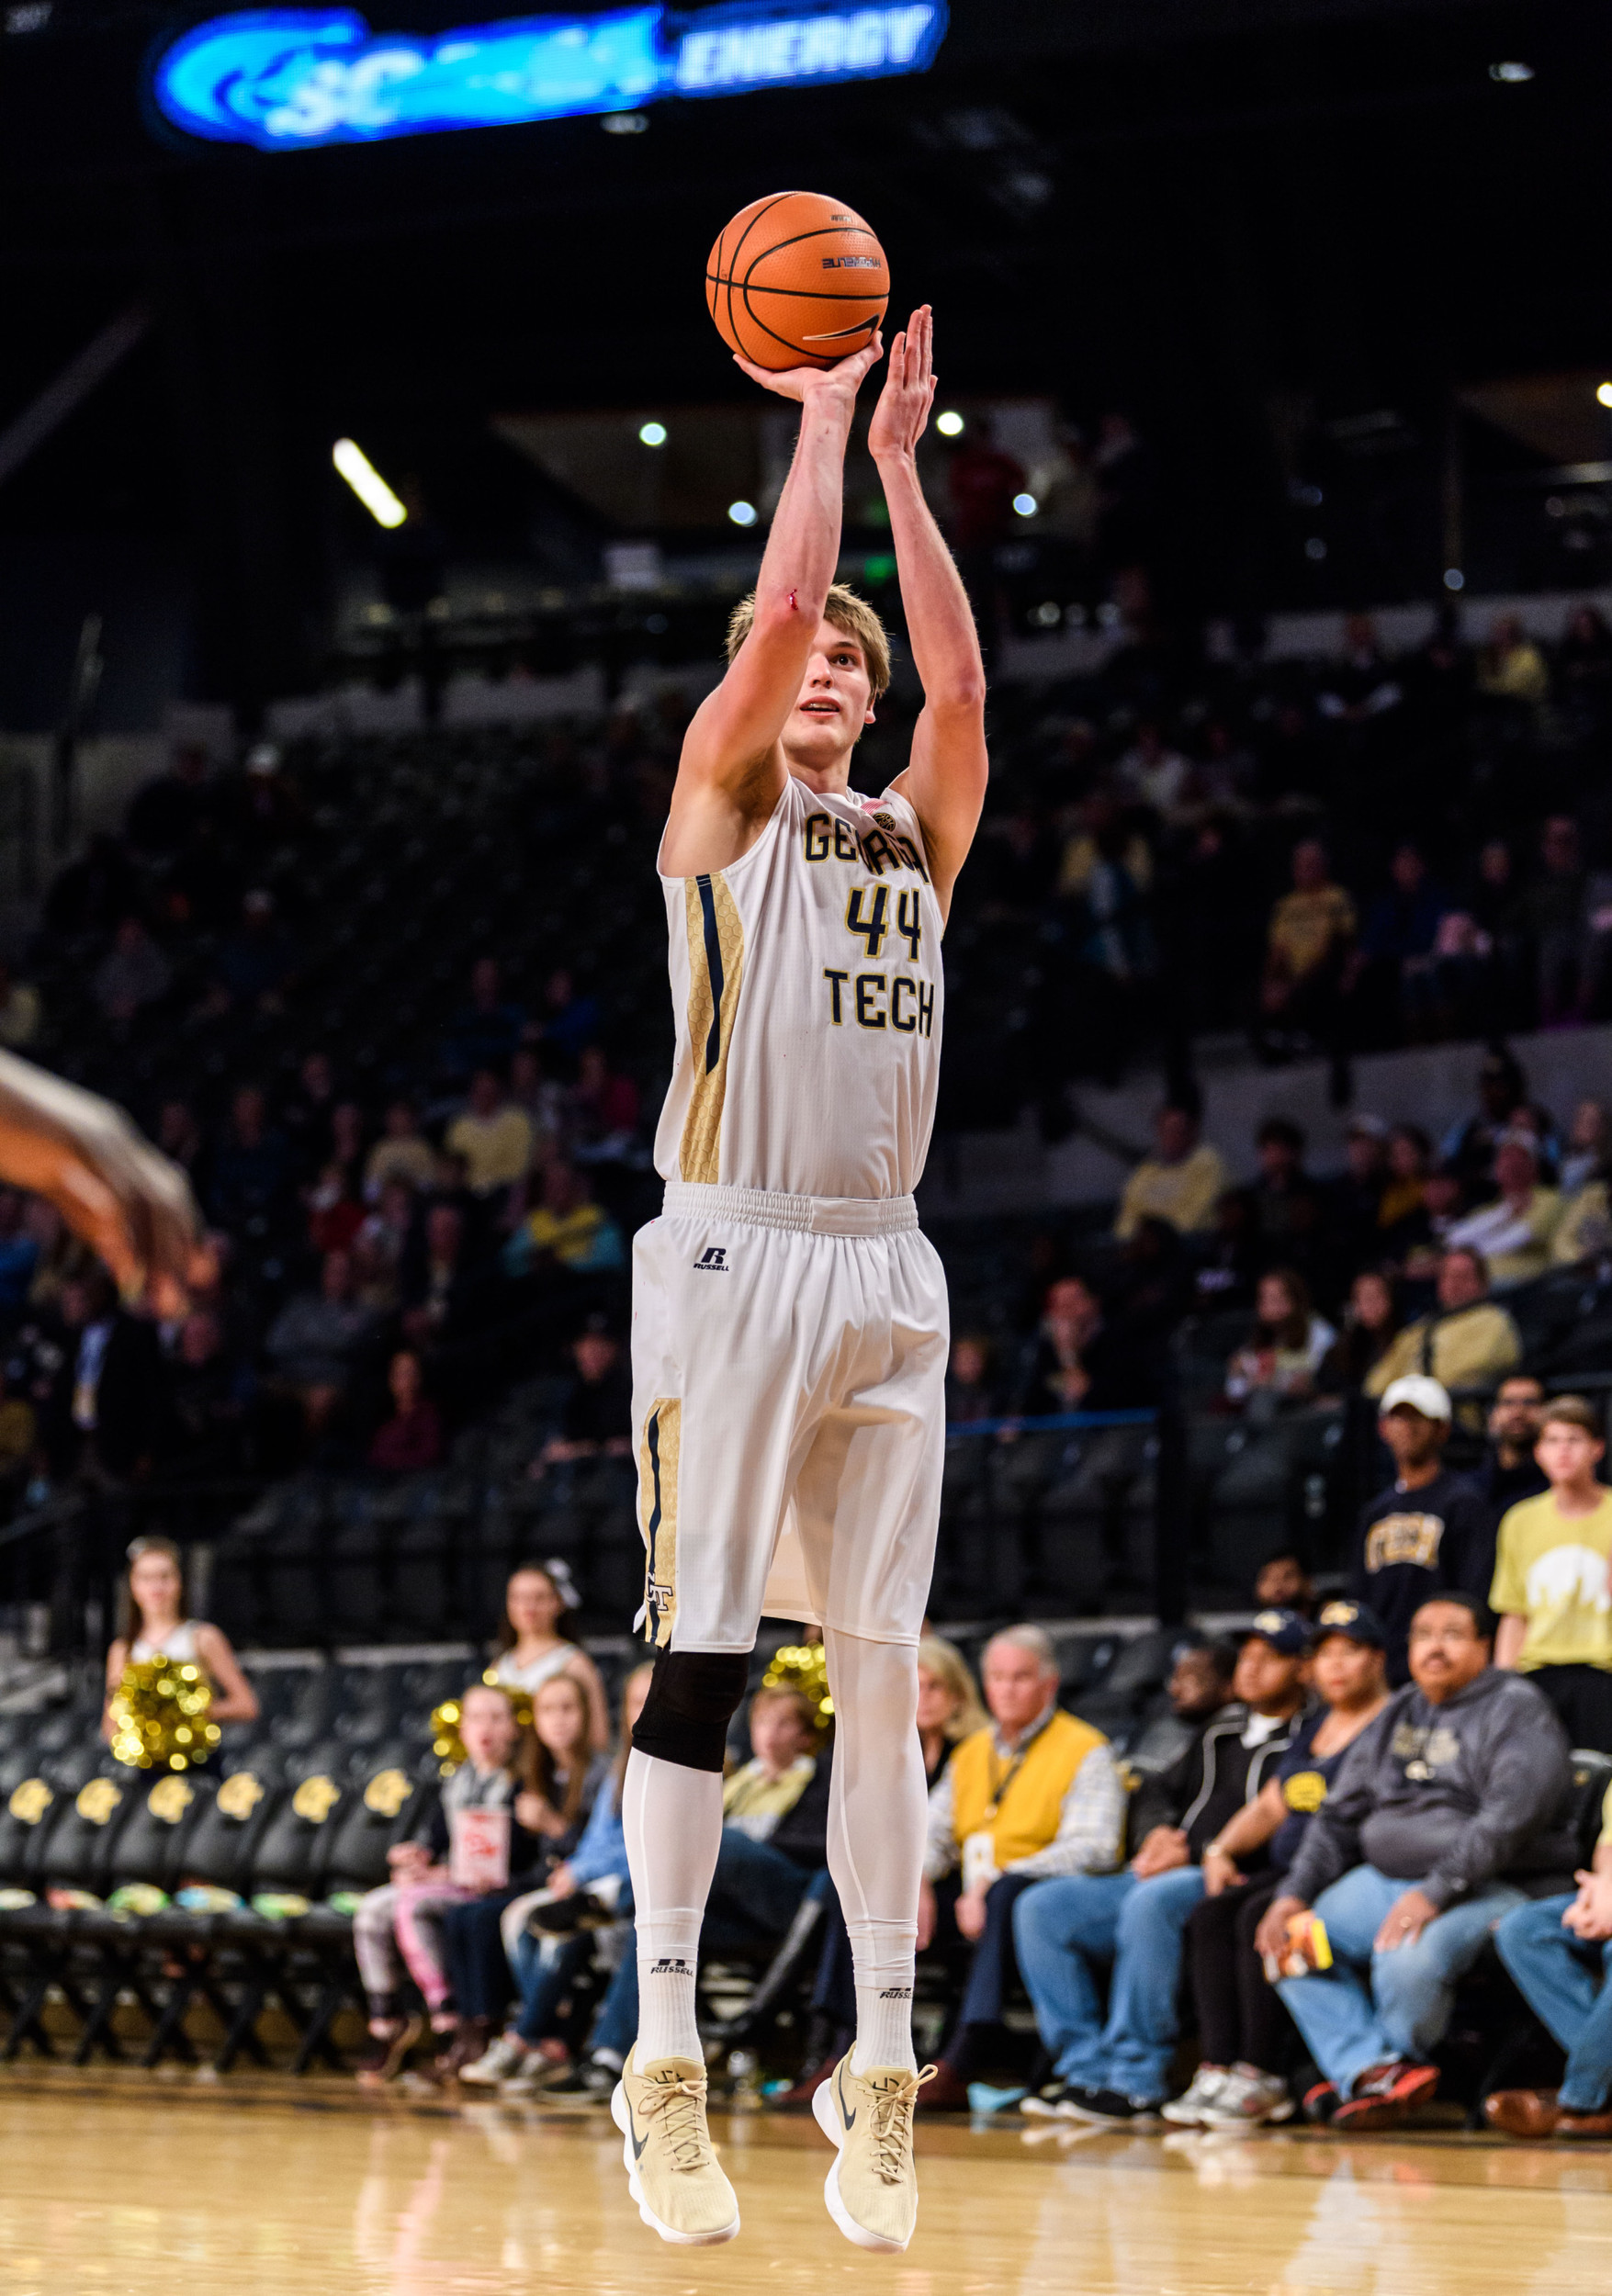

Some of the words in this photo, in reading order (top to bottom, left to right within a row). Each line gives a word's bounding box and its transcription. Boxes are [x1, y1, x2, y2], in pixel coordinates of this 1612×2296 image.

[845, 884, 921, 962] 44
[823, 968, 934, 1039] TECH
[693, 1263, 729, 1271] RUSSELL
